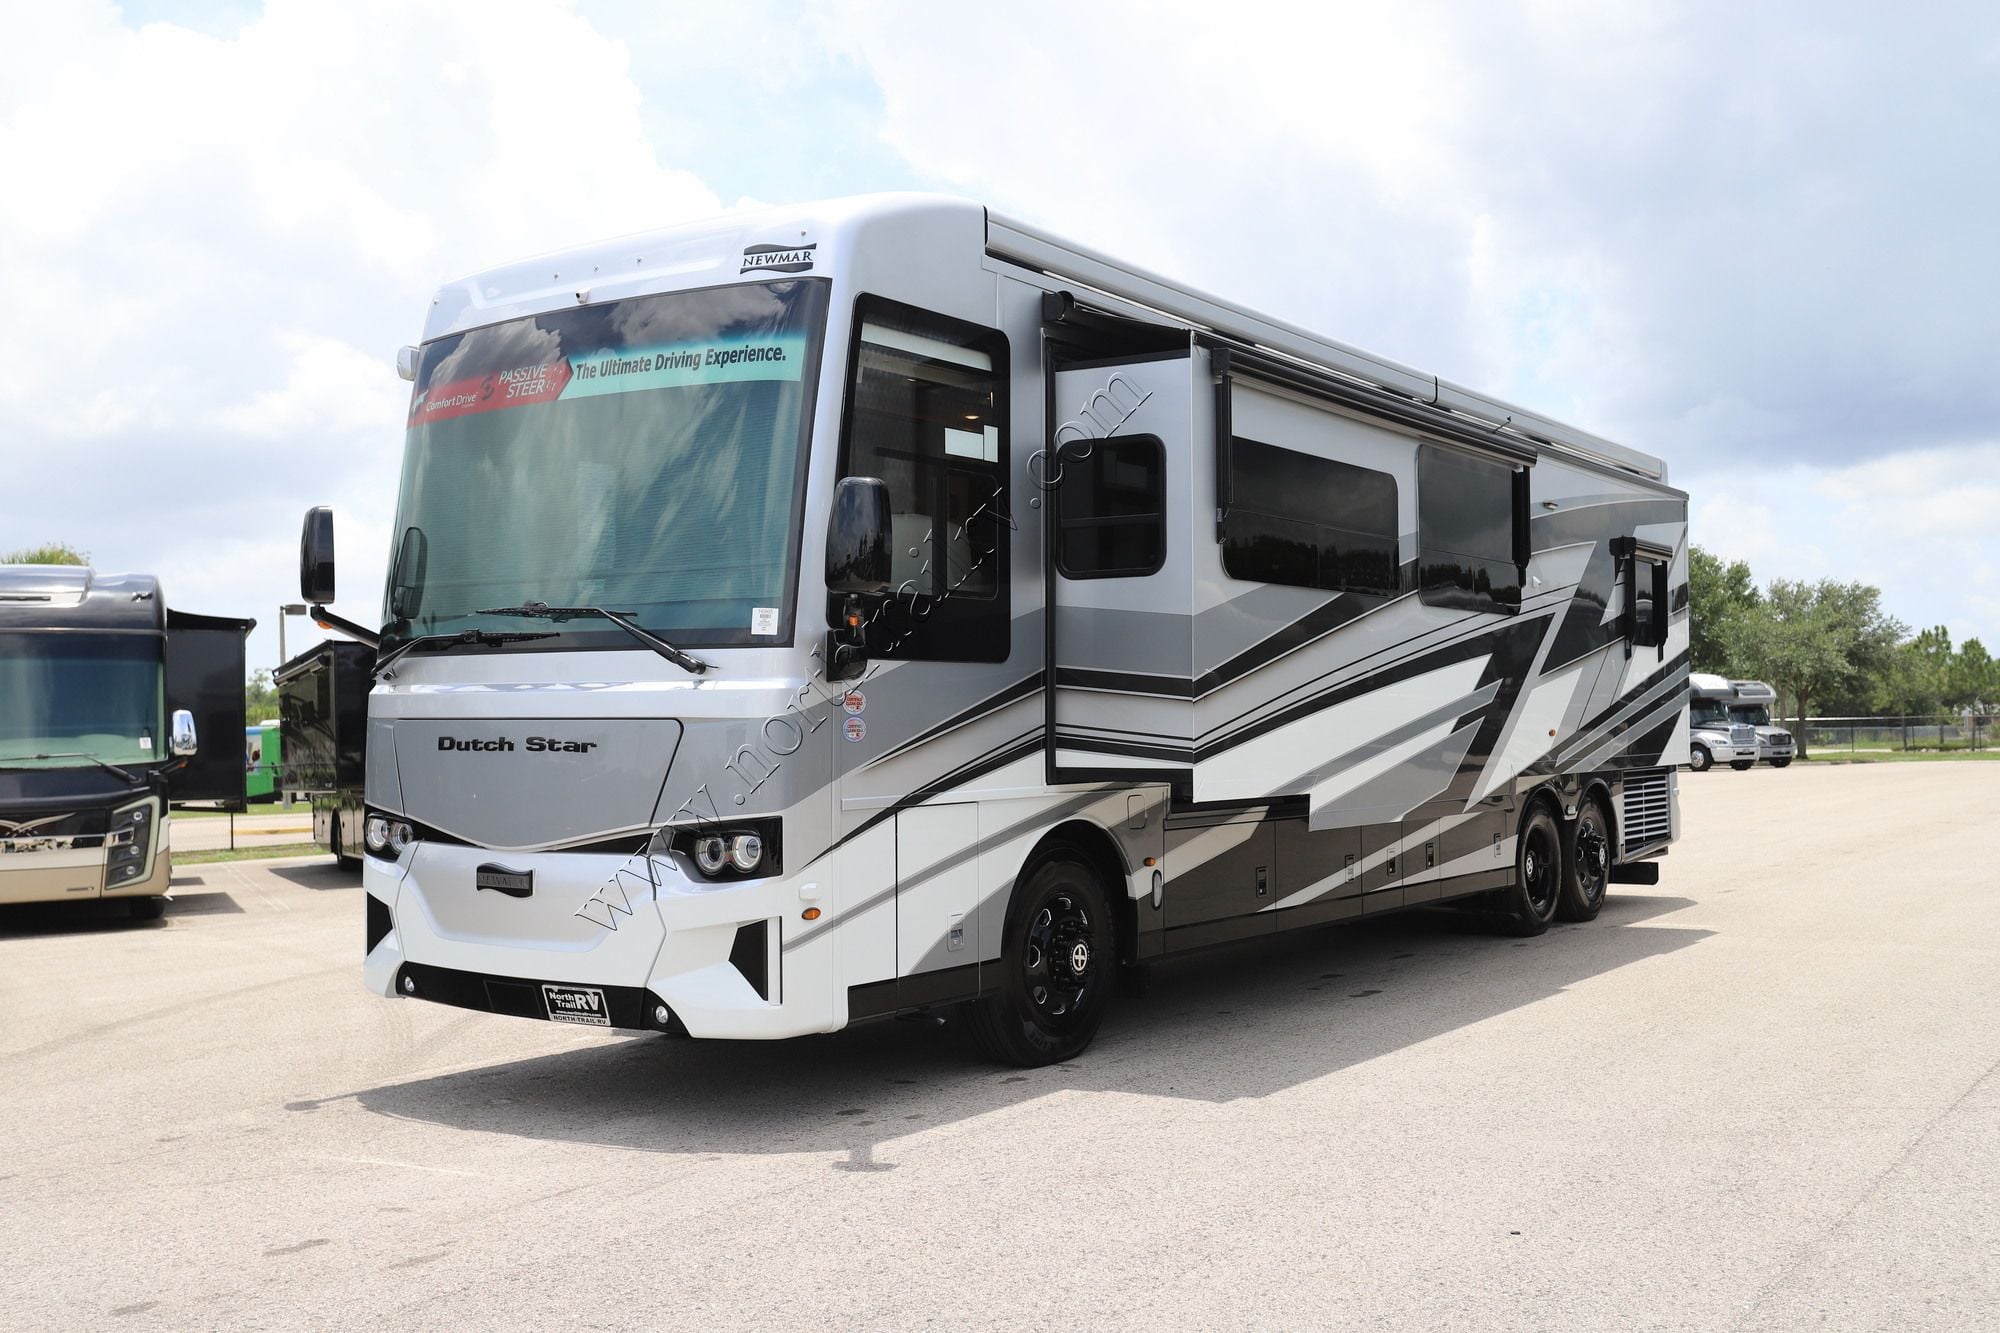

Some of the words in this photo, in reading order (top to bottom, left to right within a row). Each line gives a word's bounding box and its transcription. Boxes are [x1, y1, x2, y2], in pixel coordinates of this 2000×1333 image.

[743, 251, 812, 267] NEWMAR
[576, 363, 596, 380] The
[600, 356, 651, 378] Ultimate
[655, 350, 701, 371] Driving
[705, 345, 787, 368] Experience.
[498, 363, 548, 385] PASSIVE
[506, 380, 545, 399] STEER
[438, 736, 515, 752] Dutch
[526, 736, 598, 753] Star
[549, 991, 575, 1001] North
[555, 1000, 577, 1009] Trail
[574, 993, 599, 1011] RV
